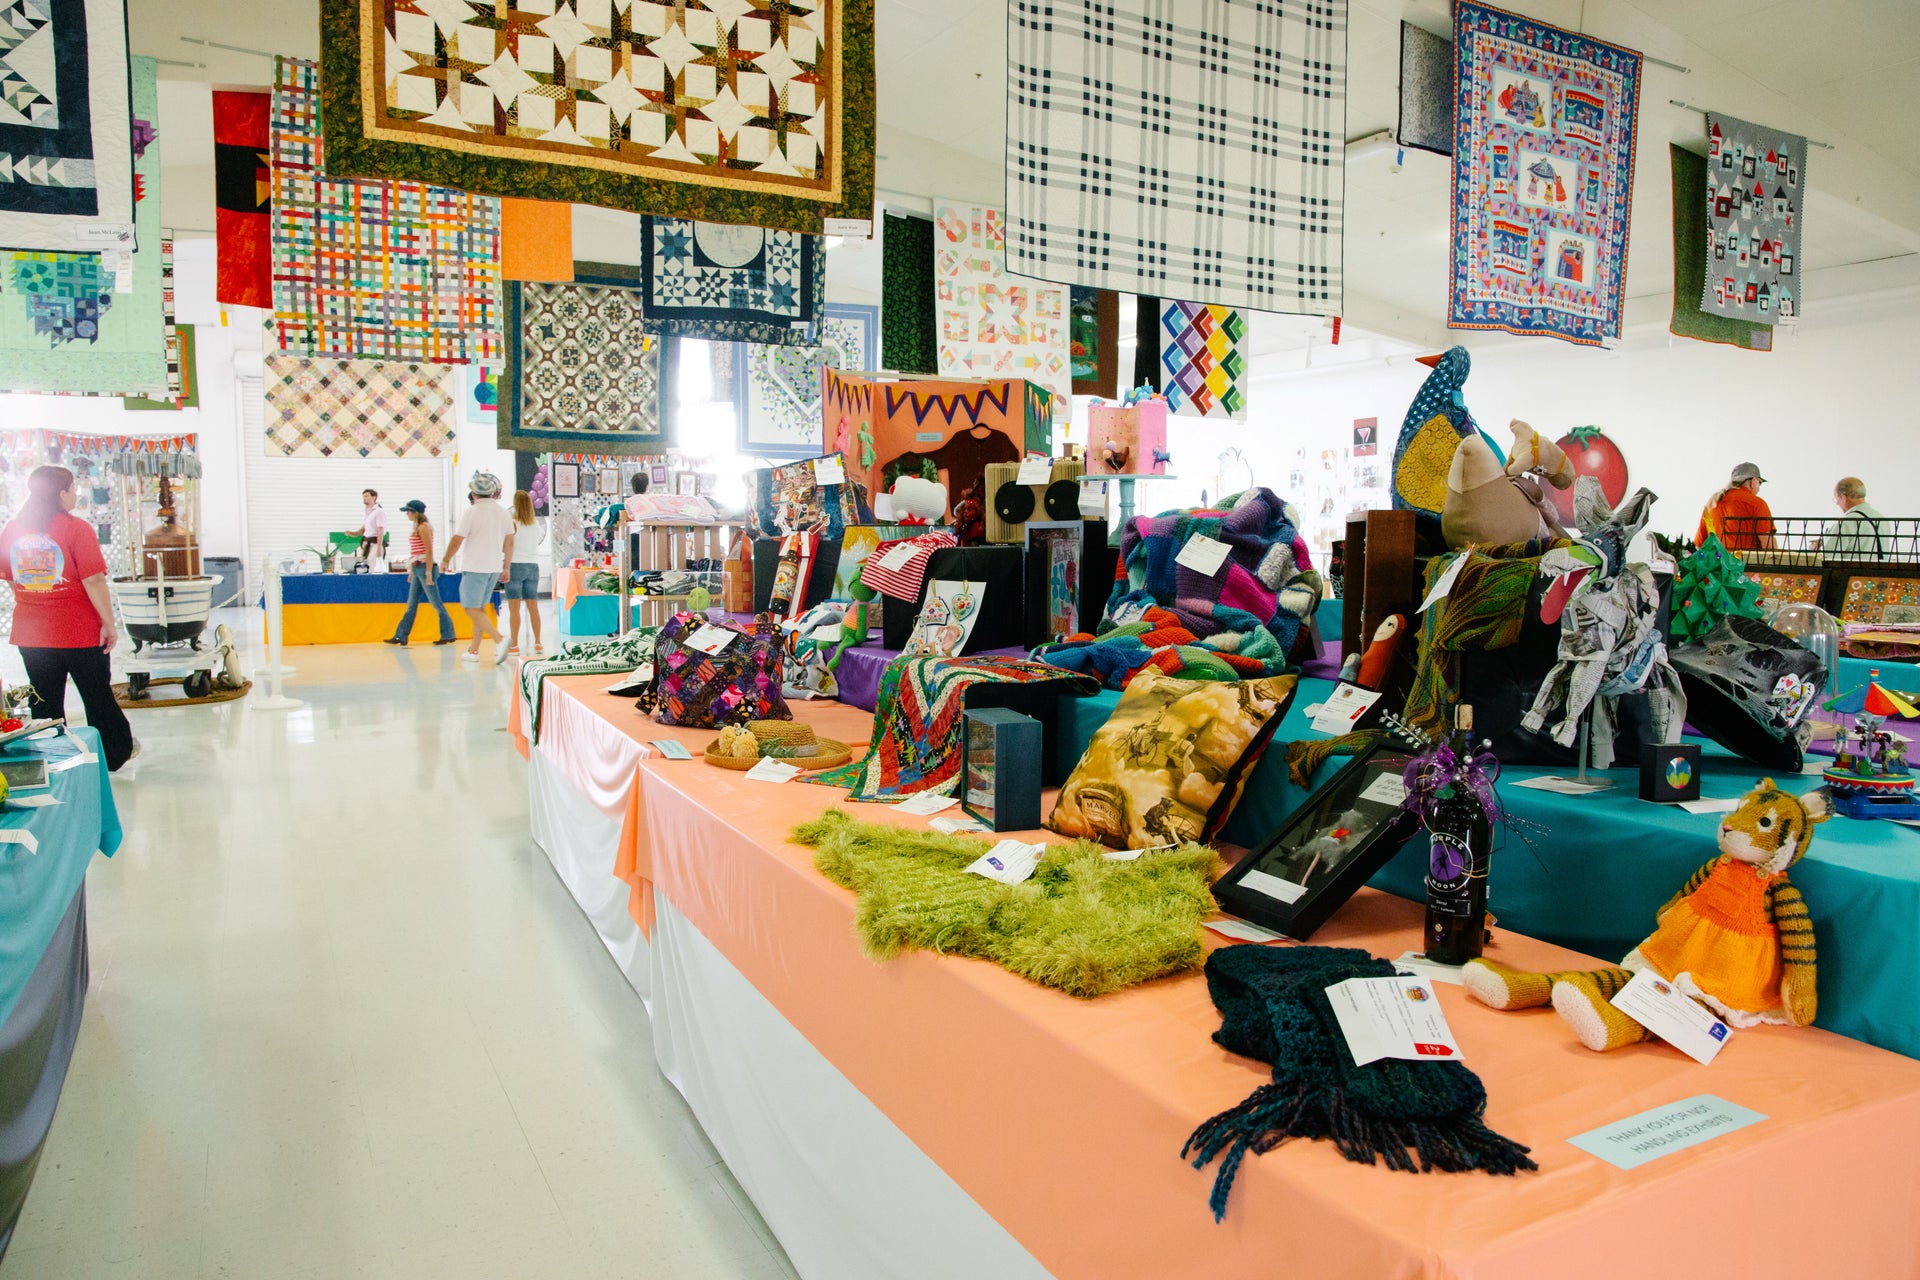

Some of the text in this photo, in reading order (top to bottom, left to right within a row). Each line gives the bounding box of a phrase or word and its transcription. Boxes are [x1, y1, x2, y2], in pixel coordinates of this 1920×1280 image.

[1432, 835, 1465, 850] URPLE
[1606, 1104, 1713, 1144] THANK YOU FOR NOT
[1629, 1114, 1734, 1153] HANDLING EXHIBITS
